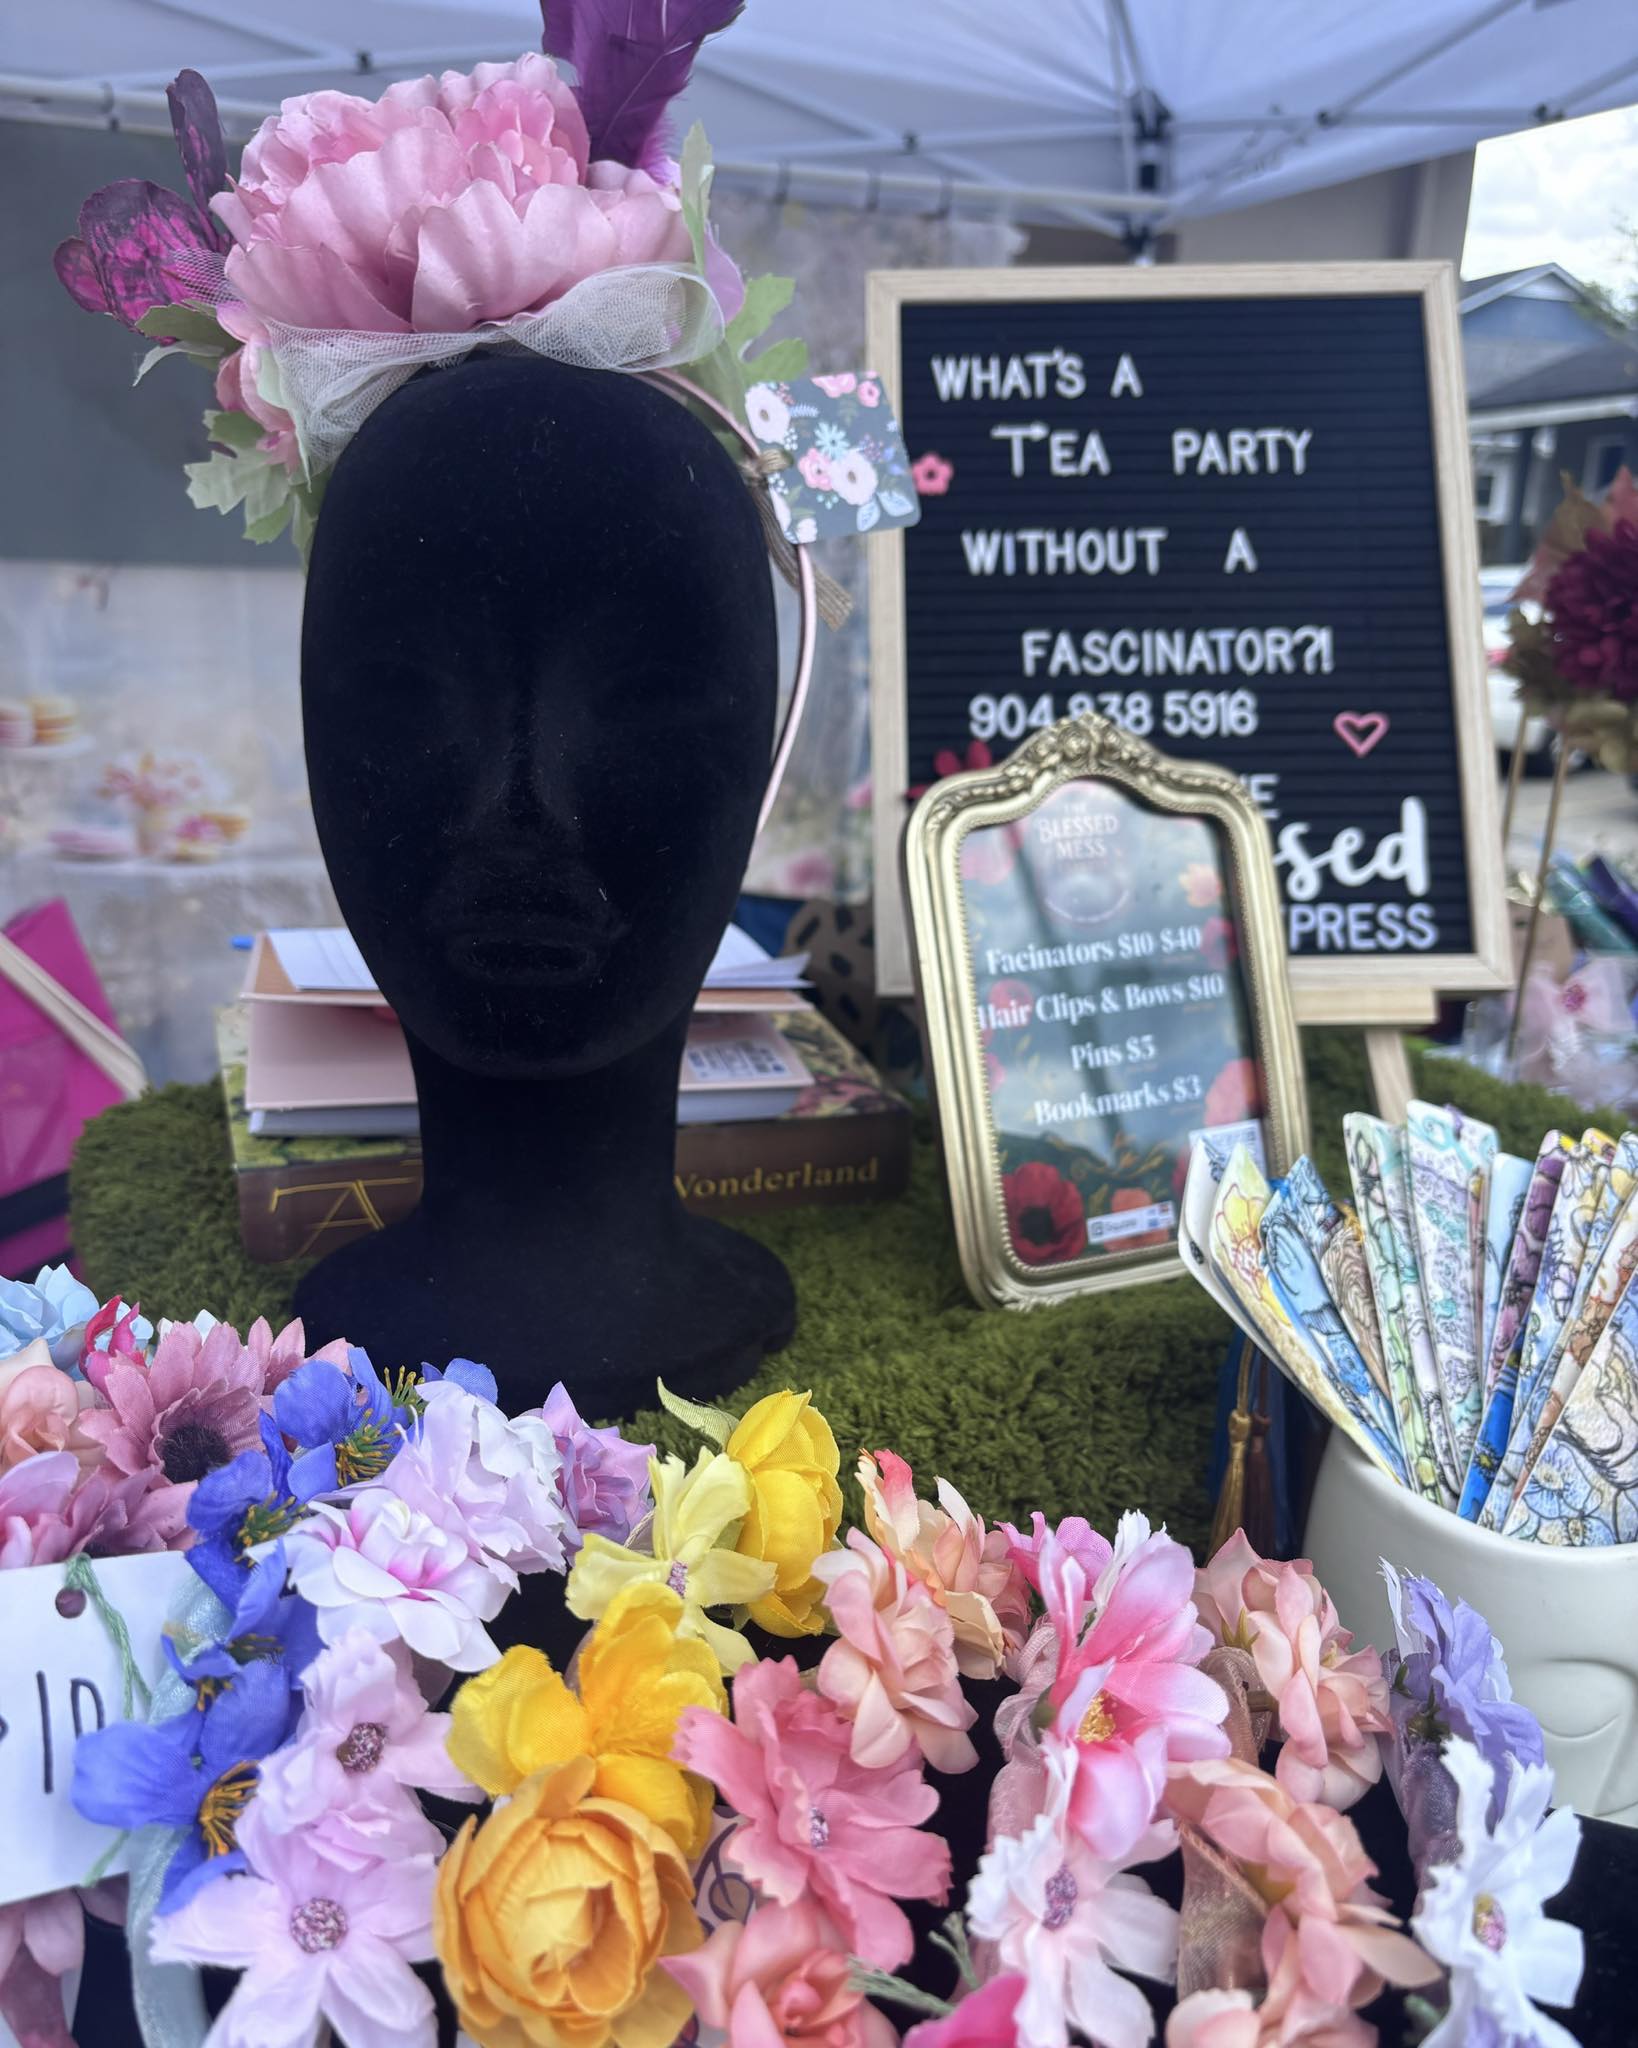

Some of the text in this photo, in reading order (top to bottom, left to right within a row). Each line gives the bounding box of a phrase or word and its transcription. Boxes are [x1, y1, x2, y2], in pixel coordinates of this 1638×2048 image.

[931, 345, 1143, 401] WHAT'S A
[991, 421, 1313, 478] TEA PARTY
[961, 527, 1258, 576] WITHOUT A
[1021, 625, 1334, 678] FASCINATOR?!
[968, 693, 1055, 740] 904
[1163, 688, 1259, 737] 5916
[1038, 813, 1119, 843] BLESSED
[1055, 838, 1107, 861] MESS
[985, 940, 1114, 976] Facinators
[1117, 930, 1154, 961] $10
[1160, 924, 1203, 952] $40
[976, 971, 1226, 1031] Hair Clips & Bows $10
[1071, 1041, 1123, 1072] Pins
[1034, 1074, 1202, 1126] Bookmarks $3
